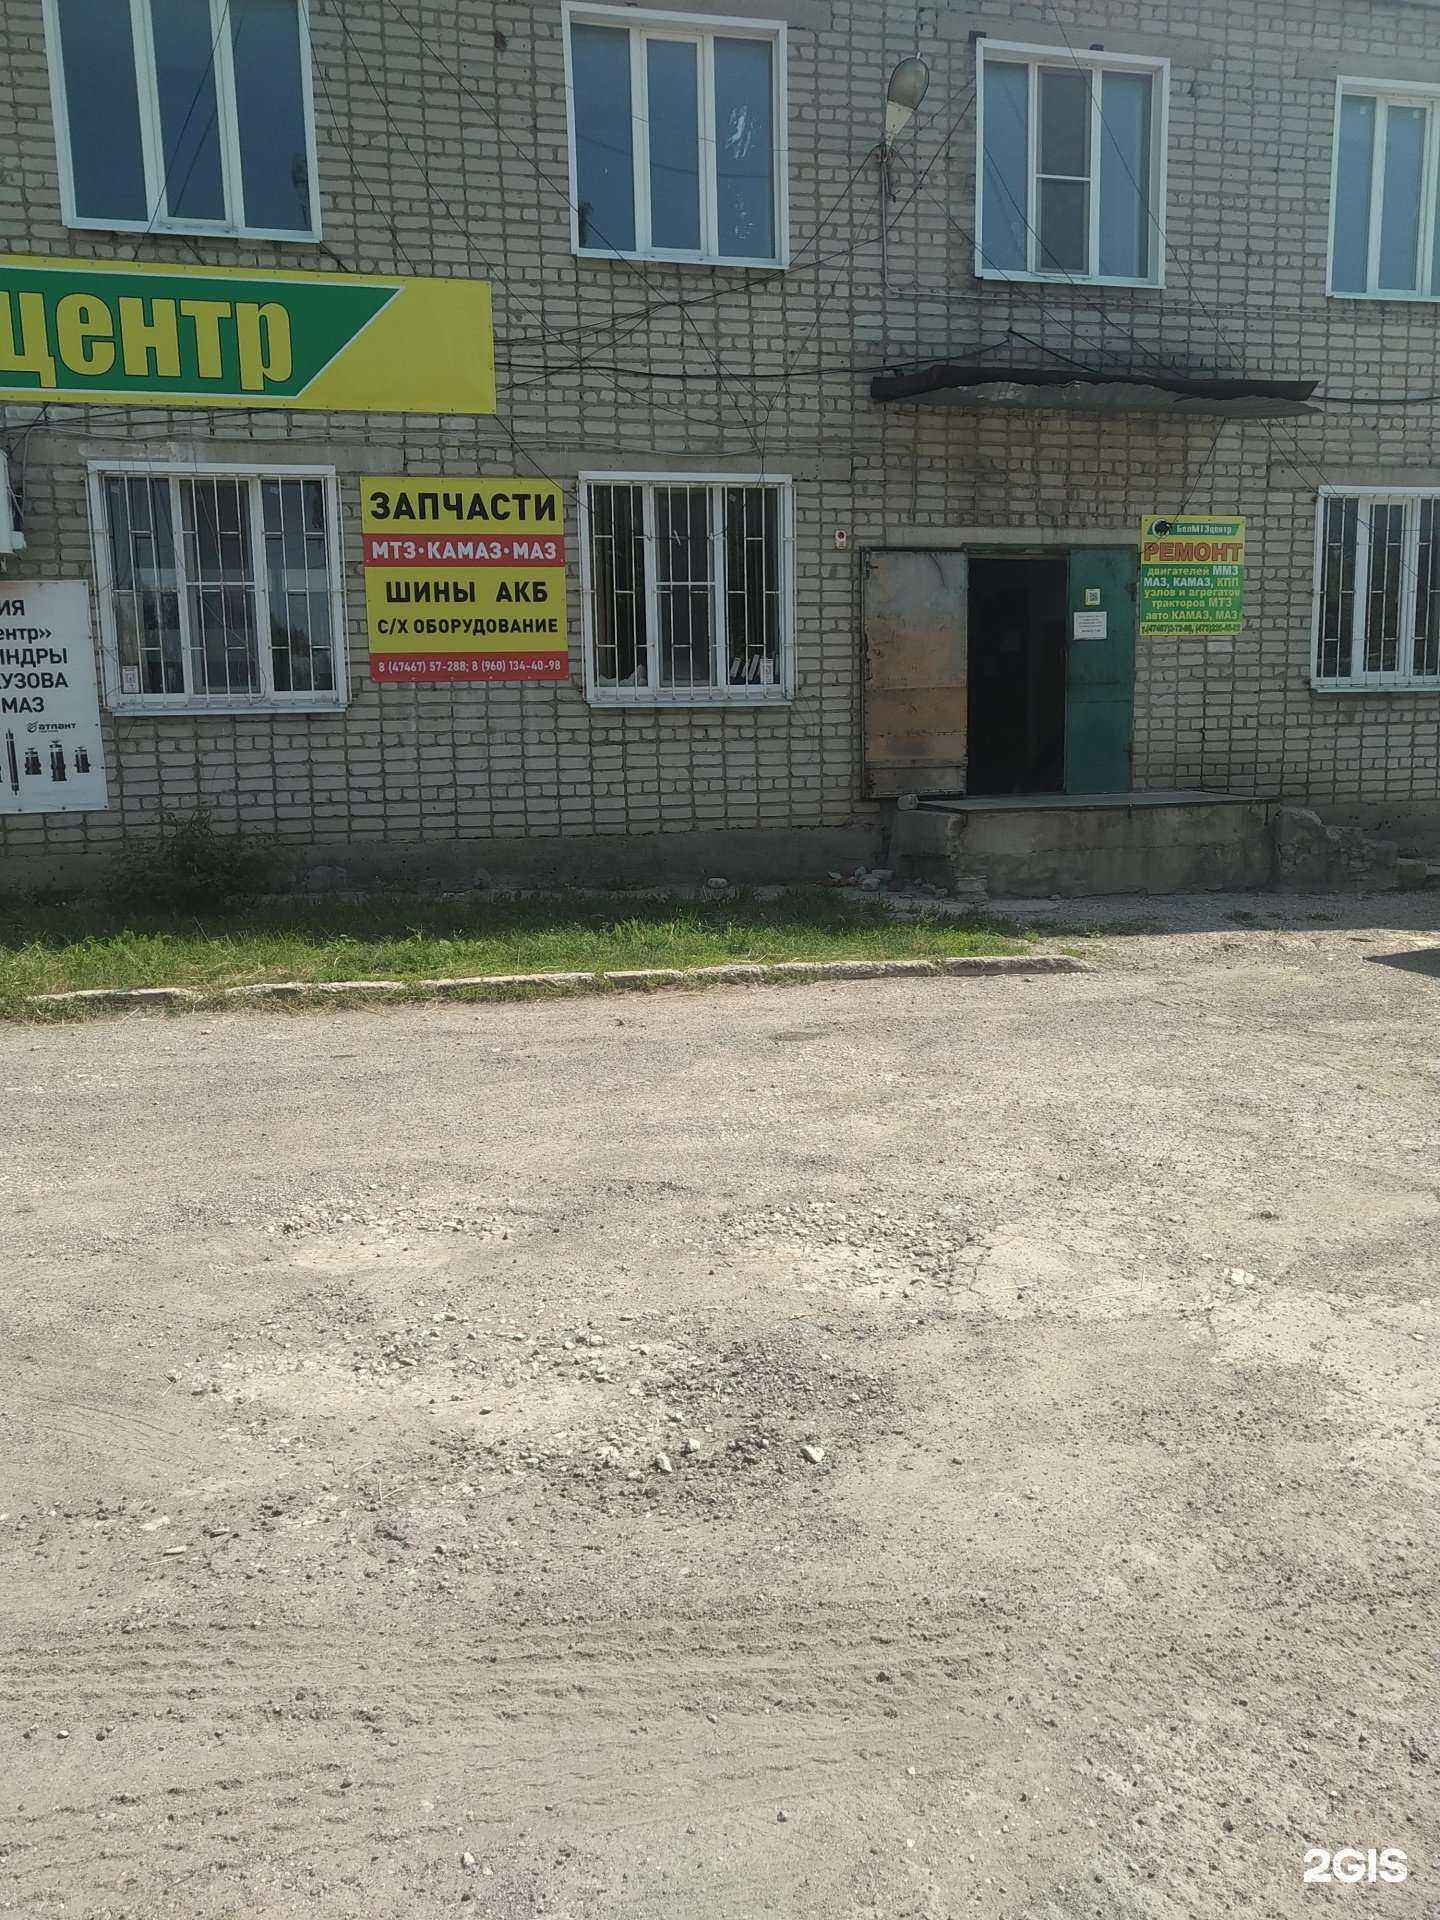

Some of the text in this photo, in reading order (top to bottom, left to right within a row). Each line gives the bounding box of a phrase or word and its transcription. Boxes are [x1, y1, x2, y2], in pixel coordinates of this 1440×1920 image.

[0, 290, 294, 392] центр
[370, 492, 556, 521] ЗАПЧАСТИ
[372, 541, 557, 560] МТЗ КАМАЗ МАЗ
[1143, 542, 1243, 562] РЕМОНТ
[1212, 565, 1239, 575] ММЗ
[1143, 576, 1239, 588] МАЗ, КАМАЗ, КПП
[386, 581, 548, 603] ШИНЫ АКБ
[1208, 598, 1233, 608] МТЗ
[1171, 610, 1212, 621] КАМАЗ,
[1215, 610, 1238, 619] МАЗ
[377, 618, 558, 636] С/Х ОБОРУДОВАНИЕ
[378, 660, 561, 673] 8 (47467) 57-288; 8 (960) 134-40-98
[0, 672, 68, 689] УЗОВА
[2, 697, 45, 714] МАЗ
